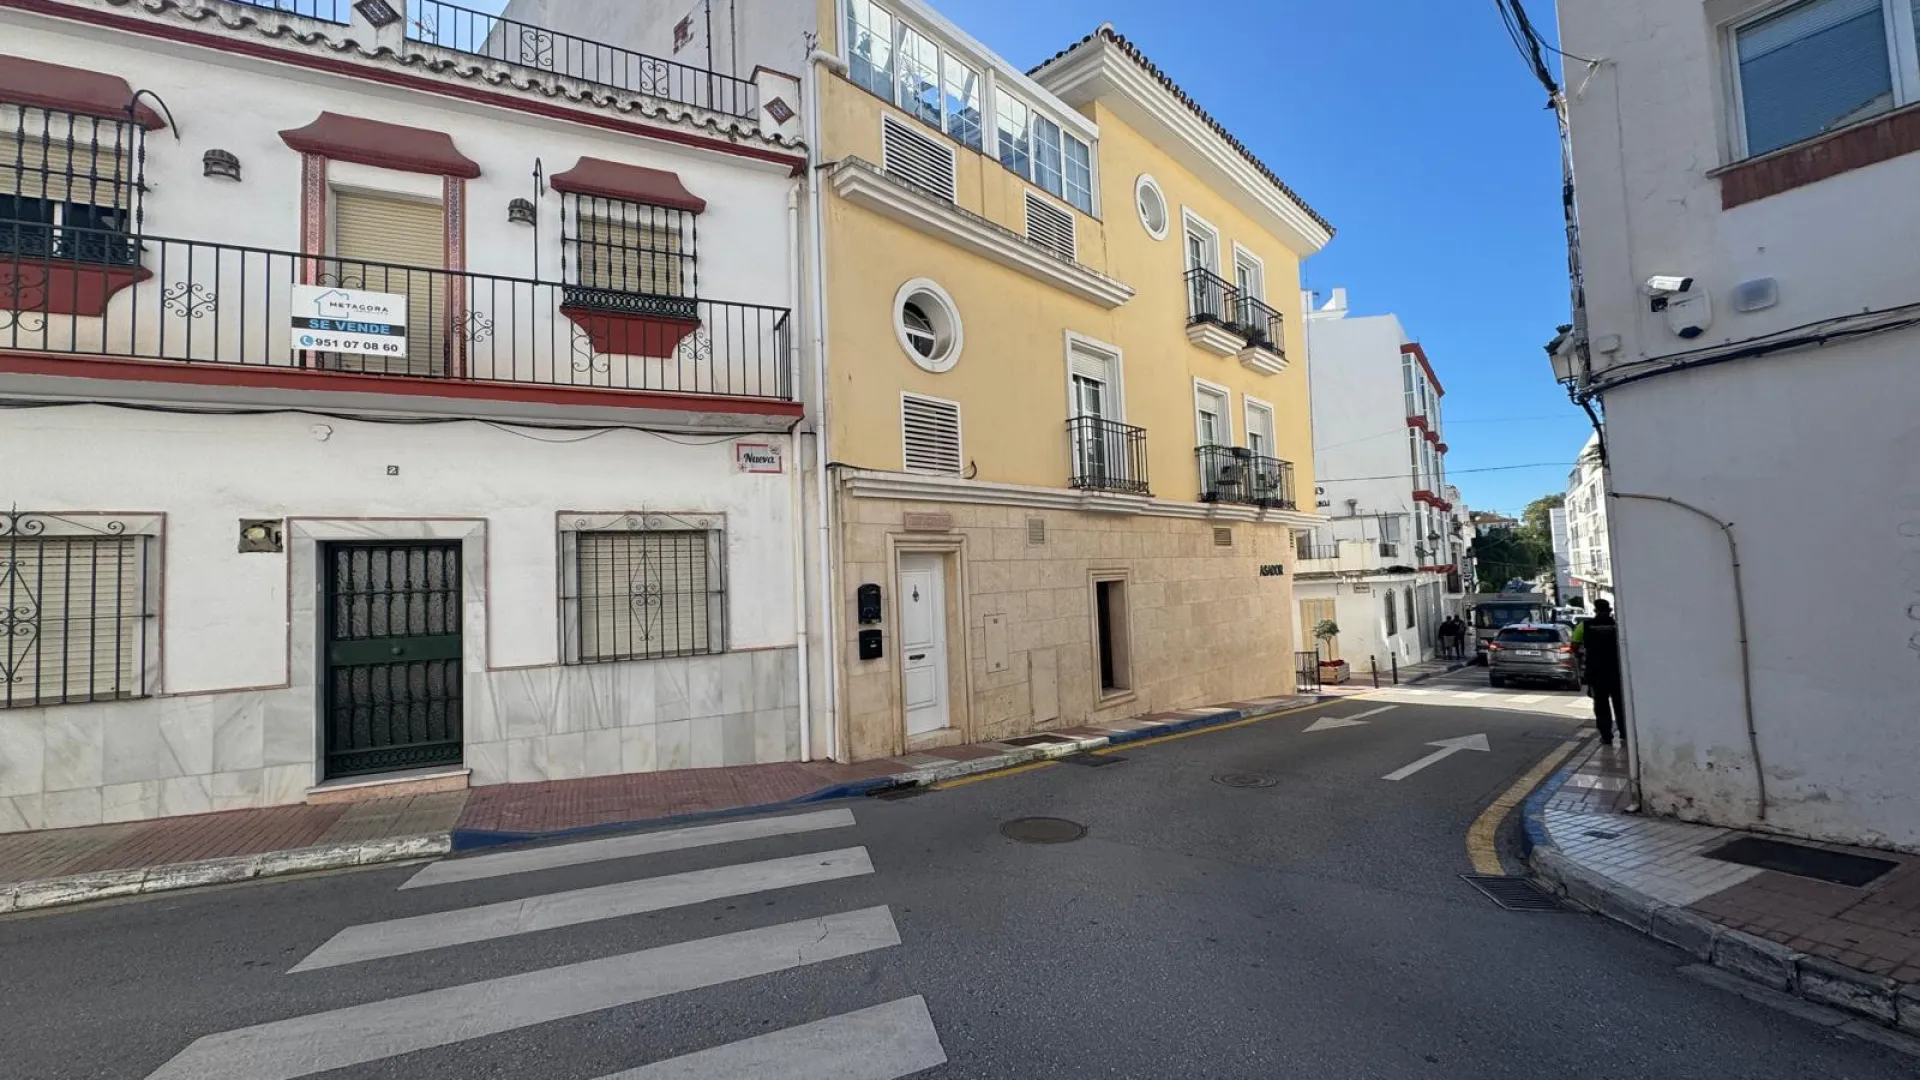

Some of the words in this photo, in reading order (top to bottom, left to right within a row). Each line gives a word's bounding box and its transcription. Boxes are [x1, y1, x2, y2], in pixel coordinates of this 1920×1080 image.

[330, 301, 389, 313] METAGORA
[309, 318, 330, 330] SE
[335, 320, 390, 335] VENDE
[315, 337, 338, 348] 951
[343, 340, 359, 349] 07
[363, 341, 379, 351] 08
[383, 343, 398, 352] 60
[743, 453, 776, 464] Nueva
